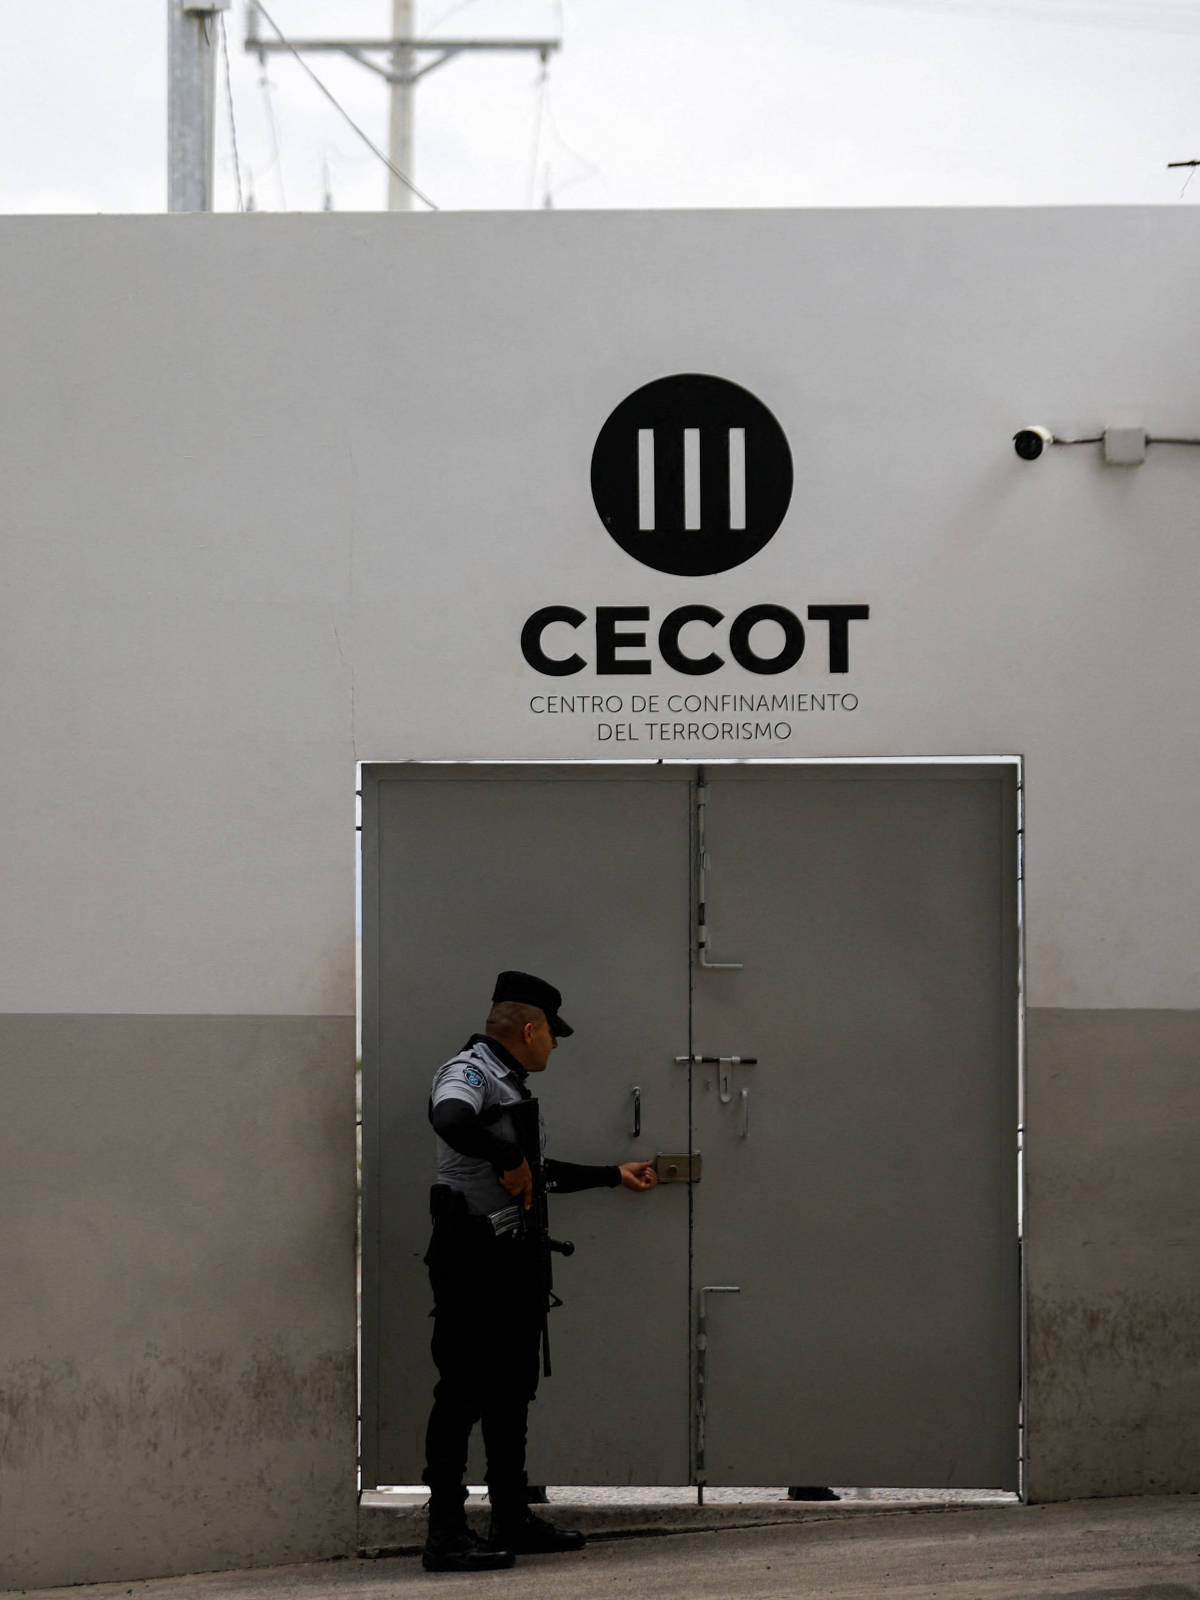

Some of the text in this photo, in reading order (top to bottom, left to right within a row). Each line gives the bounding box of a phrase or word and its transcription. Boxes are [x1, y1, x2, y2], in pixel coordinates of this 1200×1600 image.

[520, 604, 870, 677] CECOT
[530, 693, 858, 713] CENTRO DE CONFINAMIENTO
[598, 722, 791, 741] DEL TERRORISMO
